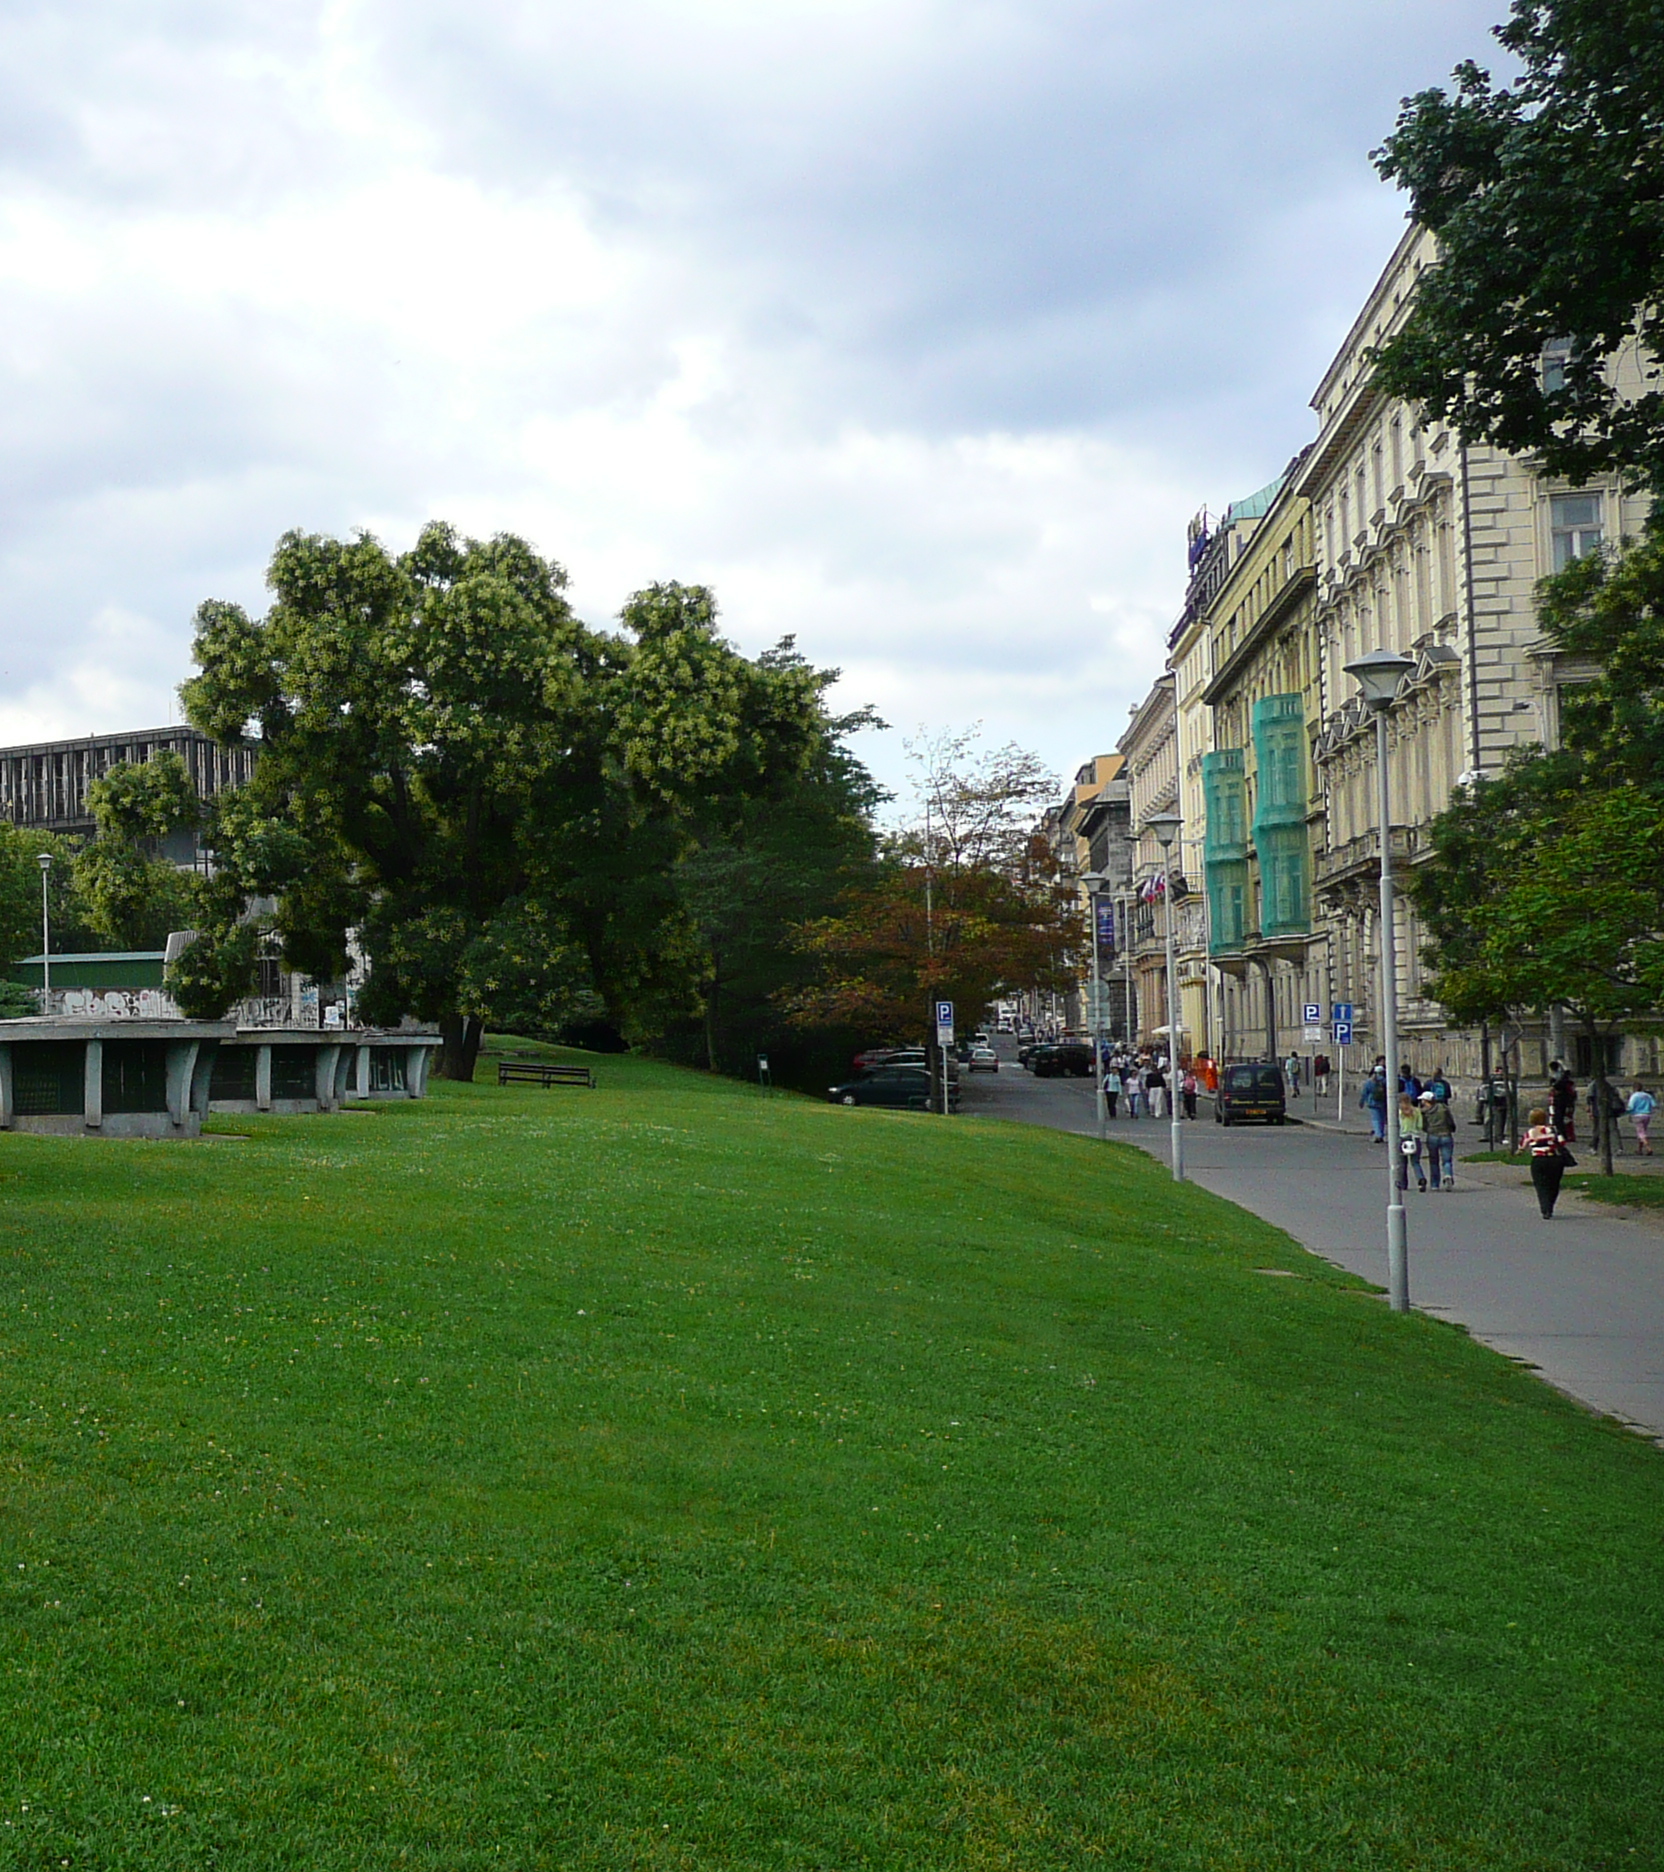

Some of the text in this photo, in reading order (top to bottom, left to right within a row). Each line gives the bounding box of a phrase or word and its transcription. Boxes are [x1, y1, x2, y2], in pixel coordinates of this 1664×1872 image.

[940, 1005, 949, 1020] P
[1306, 1006, 1317, 1019] P
[1336, 1024, 1348, 1041] P
